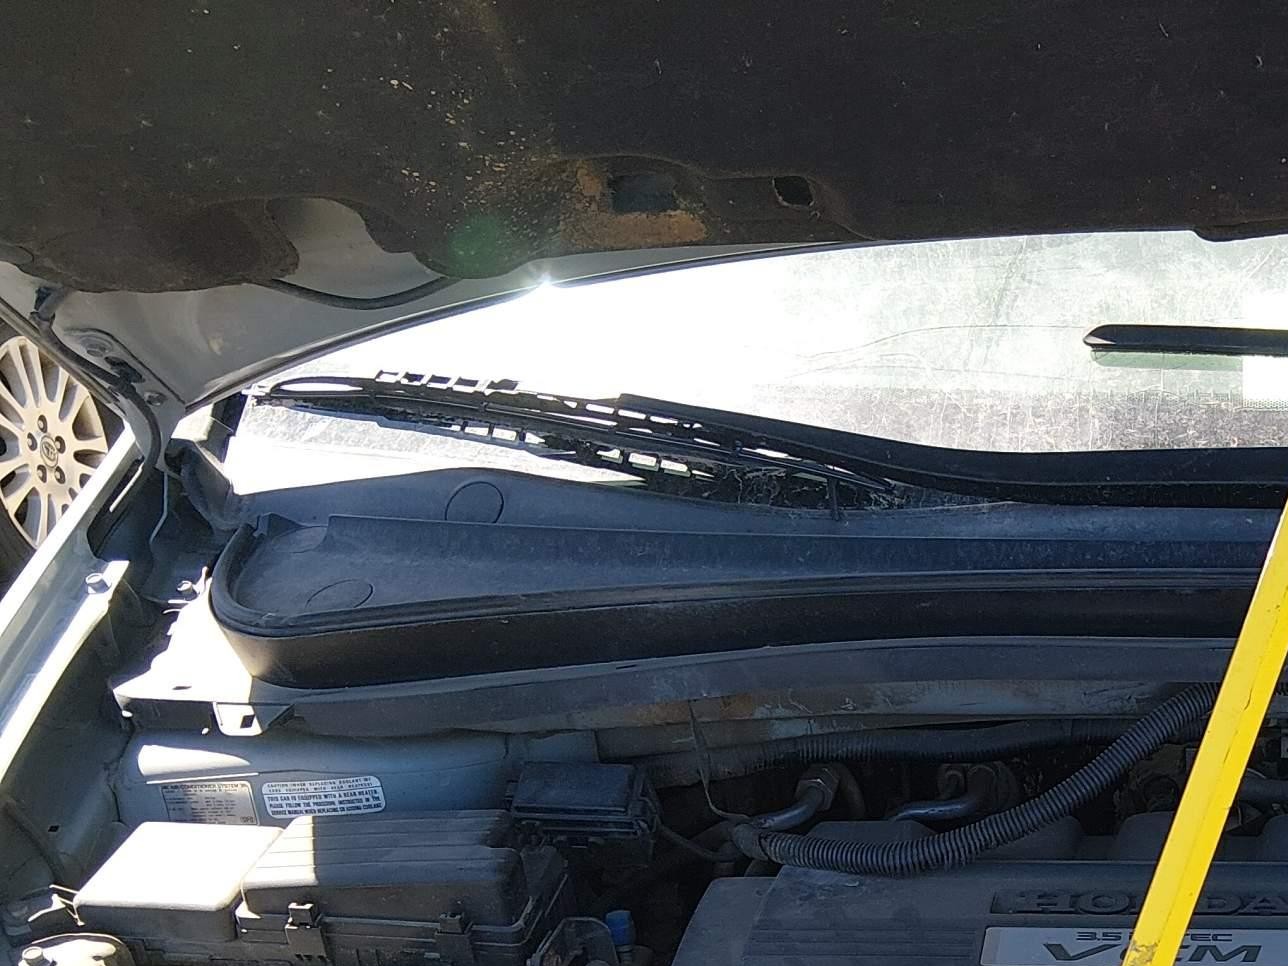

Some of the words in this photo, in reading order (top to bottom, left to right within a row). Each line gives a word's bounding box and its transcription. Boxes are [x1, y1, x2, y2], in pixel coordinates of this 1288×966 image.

[297, 792, 322, 800] EQUIPPED
[1076, 931, 1122, 941] 3.5
[1042, 943, 1262, 963] VM
